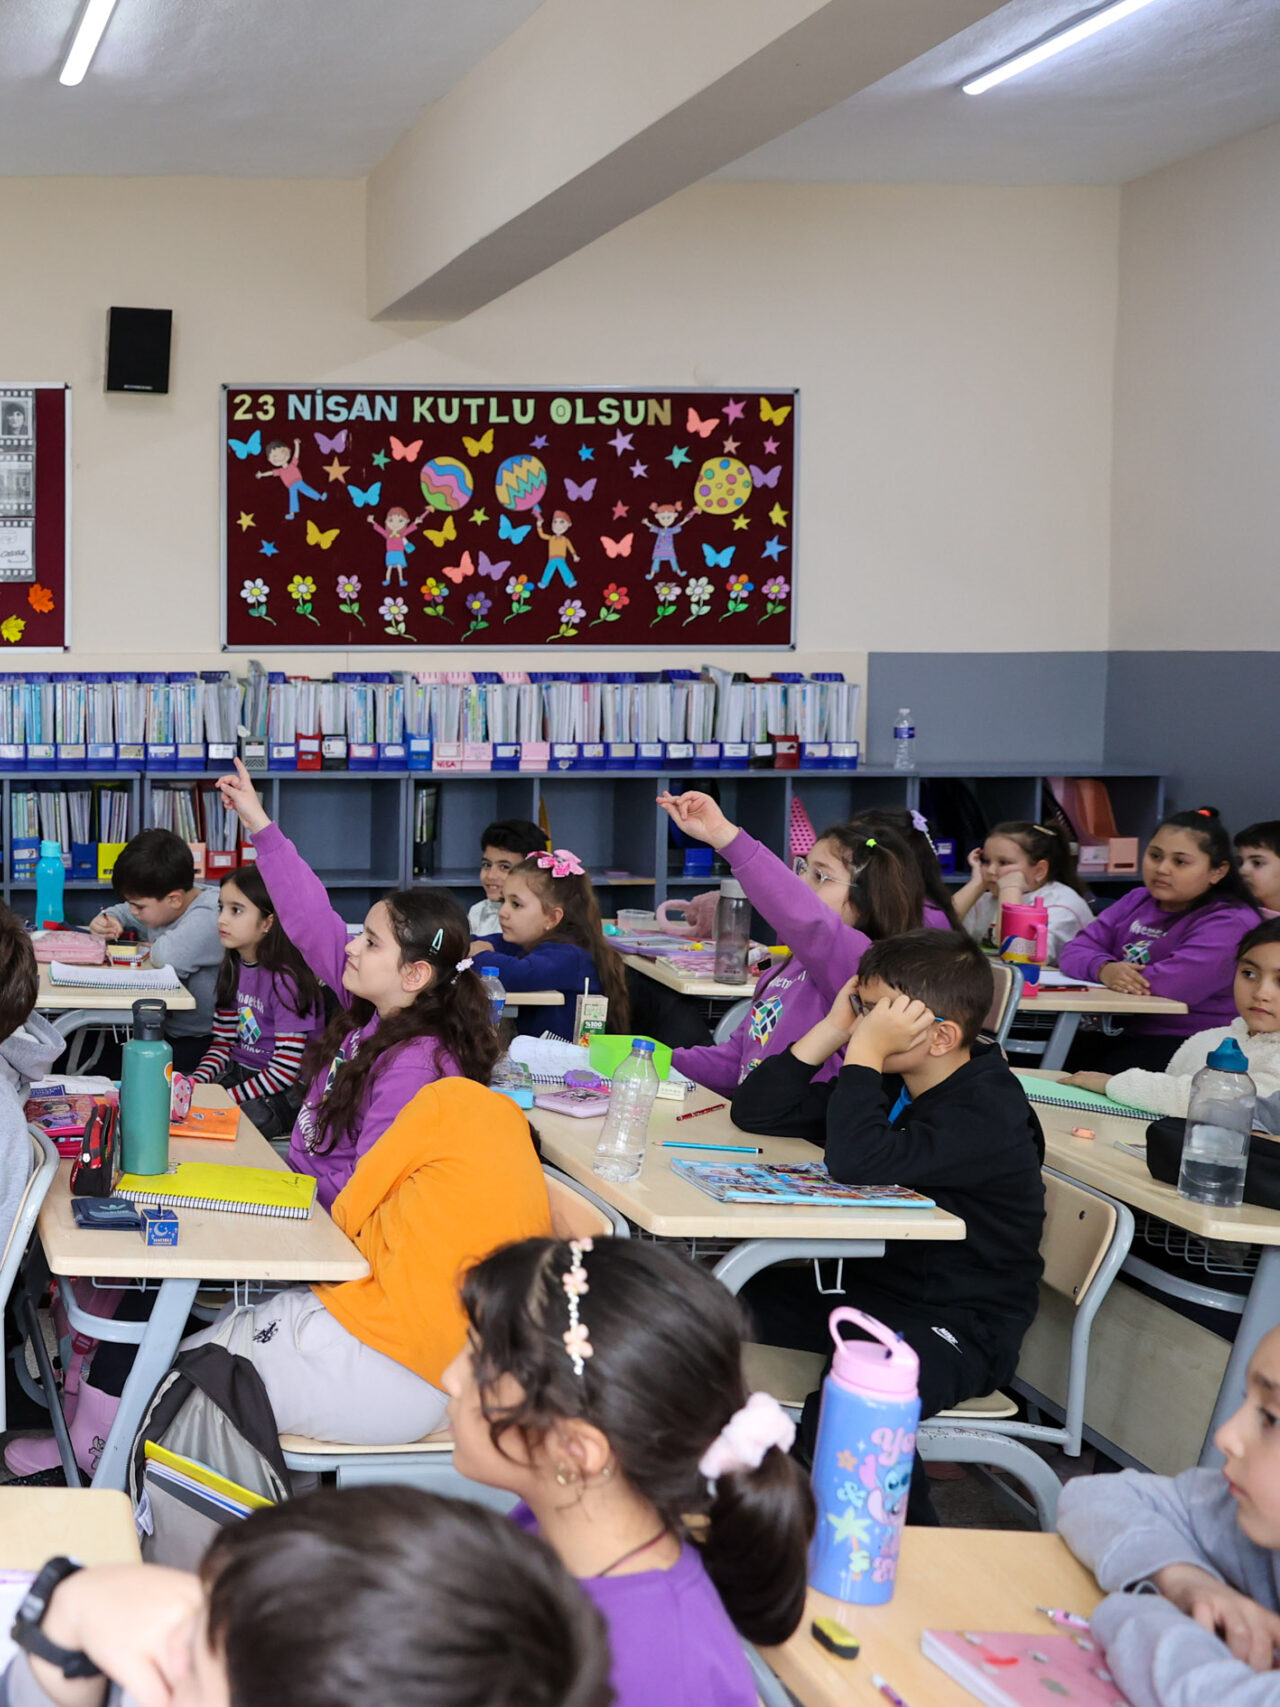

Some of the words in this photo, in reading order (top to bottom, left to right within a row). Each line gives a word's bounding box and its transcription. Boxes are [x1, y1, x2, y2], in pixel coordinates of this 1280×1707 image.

[233, 393, 275, 421] 23
[287, 387, 398, 423] NİSAN
[413, 396, 535, 425] KUTLU
[549, 397, 672, 426] OLSUN
